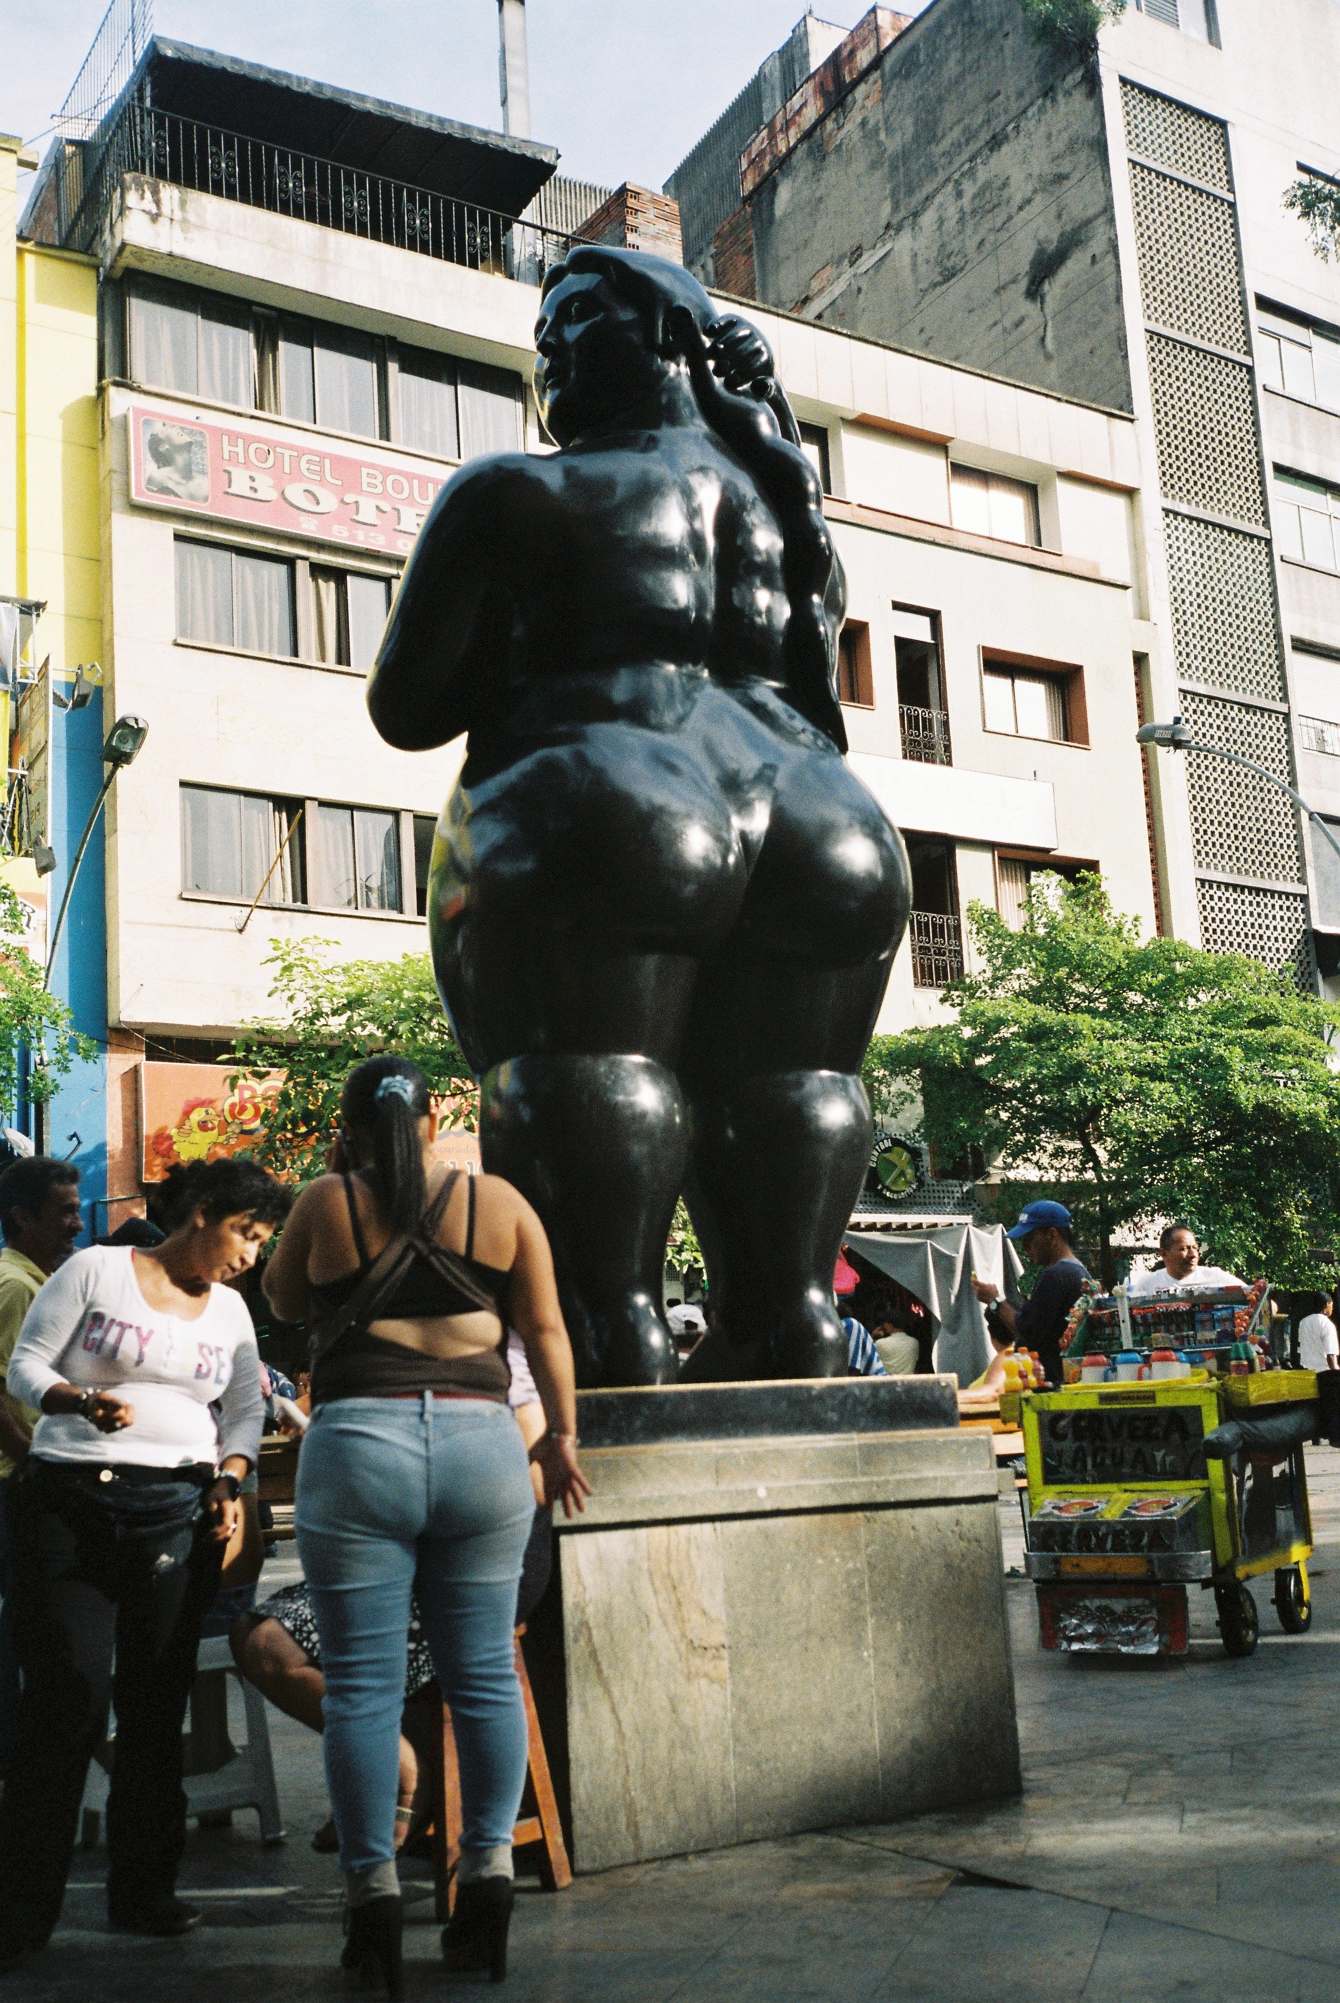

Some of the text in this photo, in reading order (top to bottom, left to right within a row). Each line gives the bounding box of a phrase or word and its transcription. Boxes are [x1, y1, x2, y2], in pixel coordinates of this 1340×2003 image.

[221, 433, 442, 506] HOTEL BOU
[82, 1311, 154, 1367] CITY
